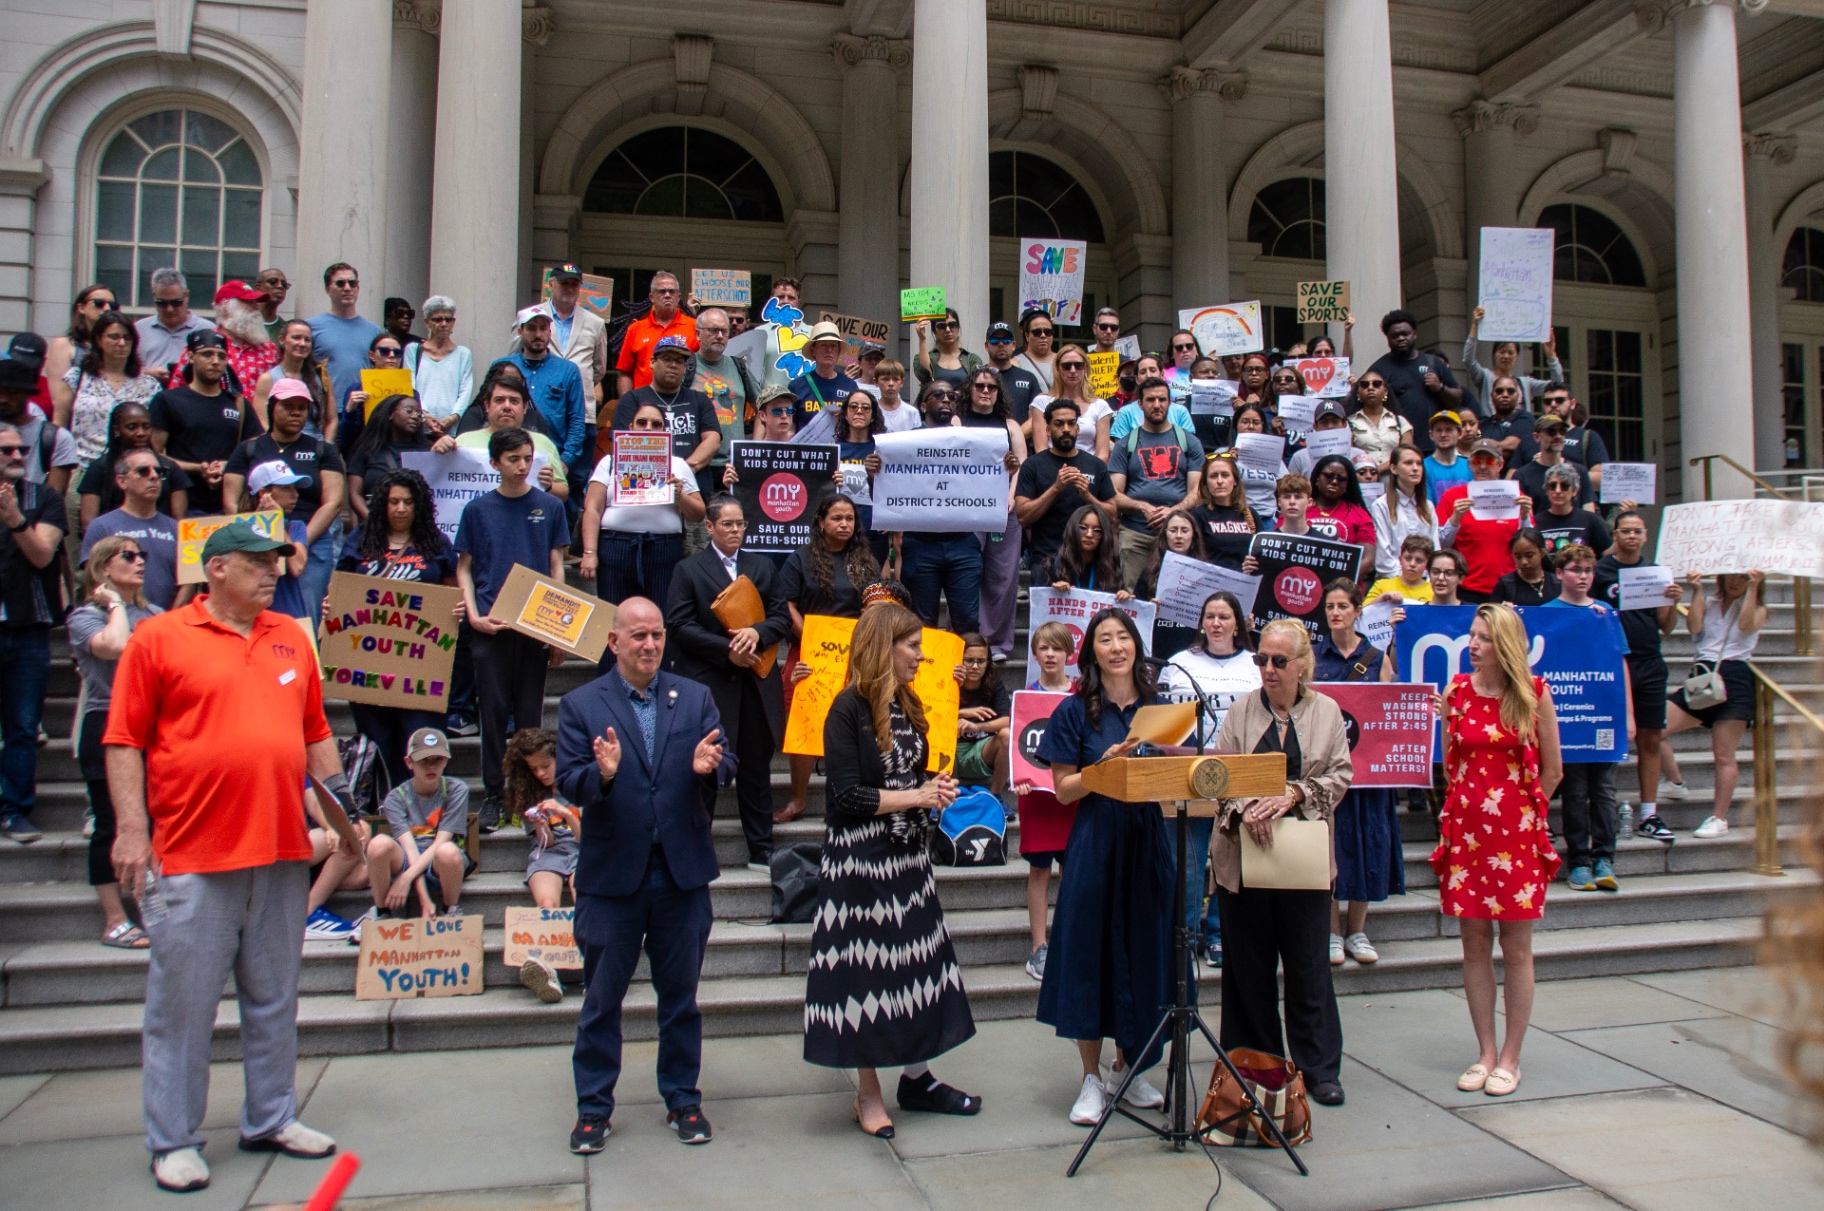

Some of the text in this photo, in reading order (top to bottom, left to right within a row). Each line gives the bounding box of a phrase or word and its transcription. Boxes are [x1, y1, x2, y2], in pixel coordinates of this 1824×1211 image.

[1026, 243, 1079, 274] SAVE
[695, 270, 715, 278] LET
[694, 279, 733, 288] CHOOSE
[1300, 281, 1345, 296] SAVE
[1307, 297, 1336, 307] OUR
[1299, 307, 1350, 322] SPORTS
[862, 321, 889, 341] OUR
[619, 437, 644, 445] STOP
[741, 449, 831, 460] DON'T CUT WHAT
[917, 448, 971, 458] REINSTATE
[744, 460, 827, 471] KIDS COUNT ON!
[884, 464, 1002, 476] MANHATTAN YOUTH
[448, 473, 502, 483] REINSTATE
[936, 481, 949, 491] AT
[767, 499, 800, 507] manhattan
[886, 497, 997, 507] DISTRICT 2 SCHOOLS!
[758, 525, 811, 534] SAVE OUR
[1208, 521, 1252, 534] WAGNE
[149, 528, 175, 541] York
[746, 535, 811, 545] AFTER-SCHO
[1261, 538, 1353, 561] DON'T CUT WHAT
[1663, 538, 1736, 560] STRONG
[1262, 548, 1347, 571] KIDS COUNT ON!
[1678, 554, 1734, 572] STRONG
[365, 588, 423, 612] SAVE
[1280, 590, 1312, 602] manhattan
[1048, 598, 1087, 608] HANDS
[1287, 598, 1304, 607] youth
[1049, 607, 1085, 617] AFTER
[325, 608, 456, 652] MANHATTAN
[1368, 620, 1391, 630] REINS
[350, 634, 426, 660] YOUTH
[1543, 671, 1615, 682] MANHATTAN
[1550, 684, 1584, 695] OUTH
[1401, 693, 1429, 701] KEEP
[1383, 702, 1428, 711] WAGNER
[1386, 712, 1428, 721] STRONG
[1580, 715, 1613, 724] Programs
[1363, 722, 1428, 731] AFTER 2:45
[1392, 744, 1427, 754] AFTER
[1386, 754, 1426, 764] SCHOOL
[1370, 764, 1426, 774] MATTERS!
[540, 909, 576, 921] SAV
[378, 920, 464, 940] WE LOVE
[369, 950, 461, 967] MANHATTAN
[378, 962, 470, 993] YOUTH!
